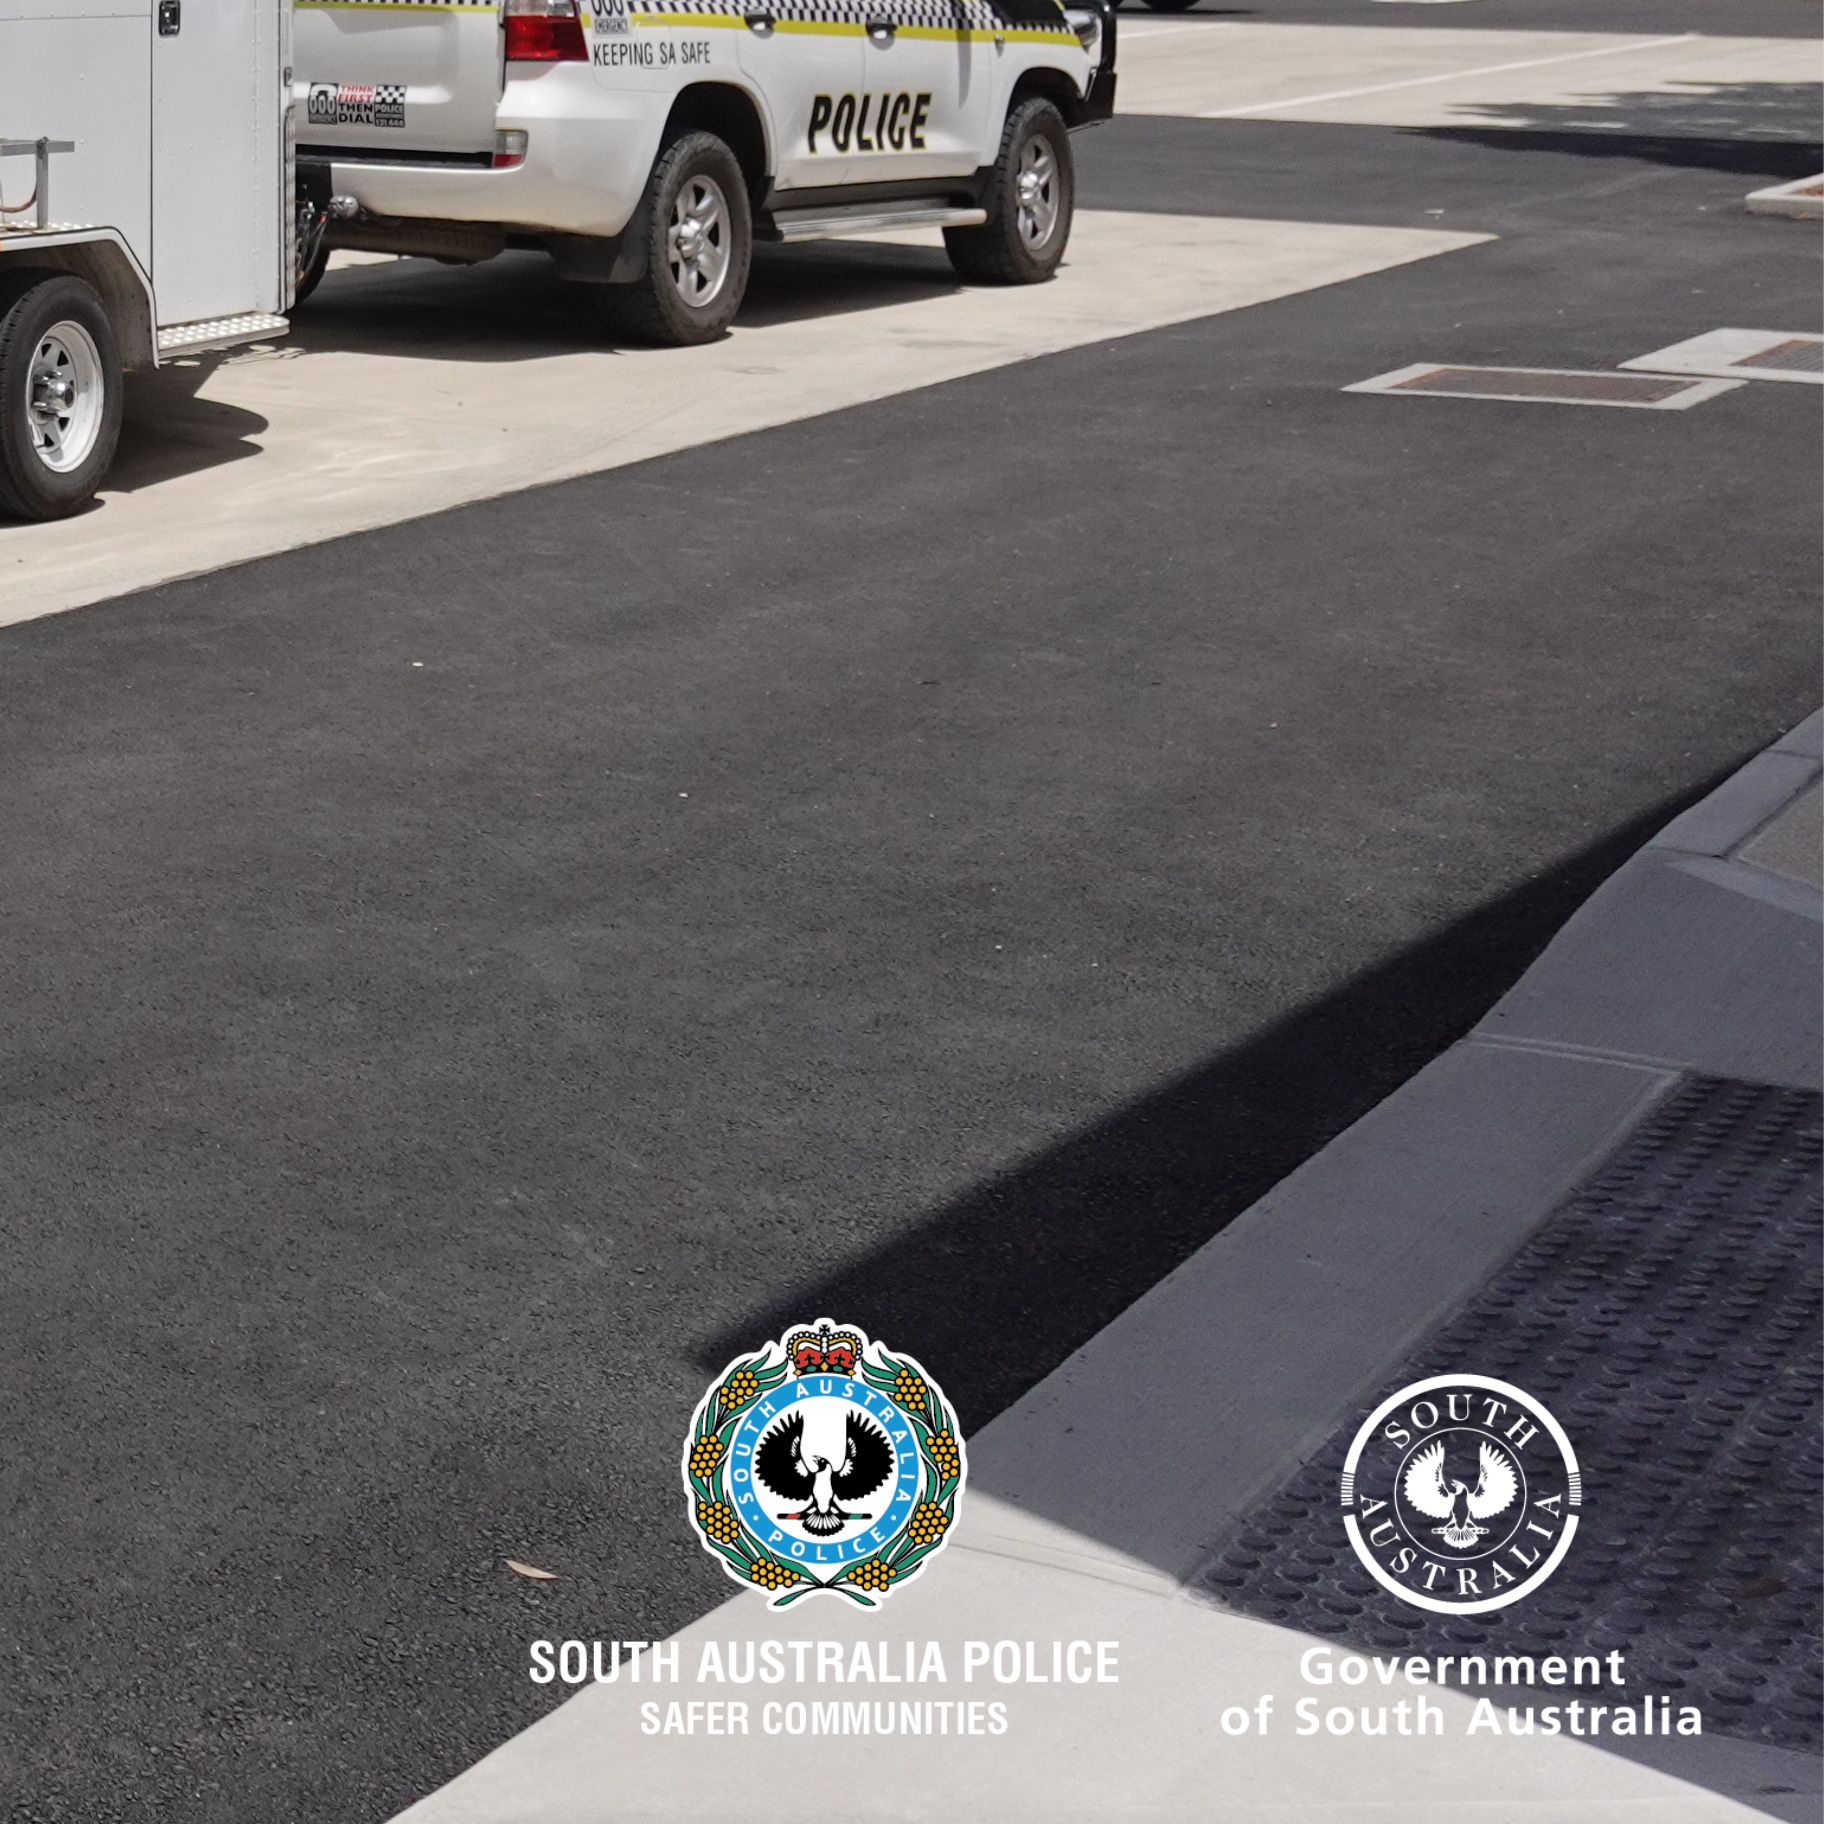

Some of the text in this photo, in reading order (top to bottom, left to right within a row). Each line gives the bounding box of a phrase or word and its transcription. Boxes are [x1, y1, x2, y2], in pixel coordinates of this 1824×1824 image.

[594, 42, 710, 66] KEEPING SA SAFE
[310, 96, 336, 114] 000
[338, 94, 373, 103] FIRST
[339, 104, 372, 113] THEN
[339, 113, 373, 123] DIAL
[808, 92, 932, 153] POLICE
